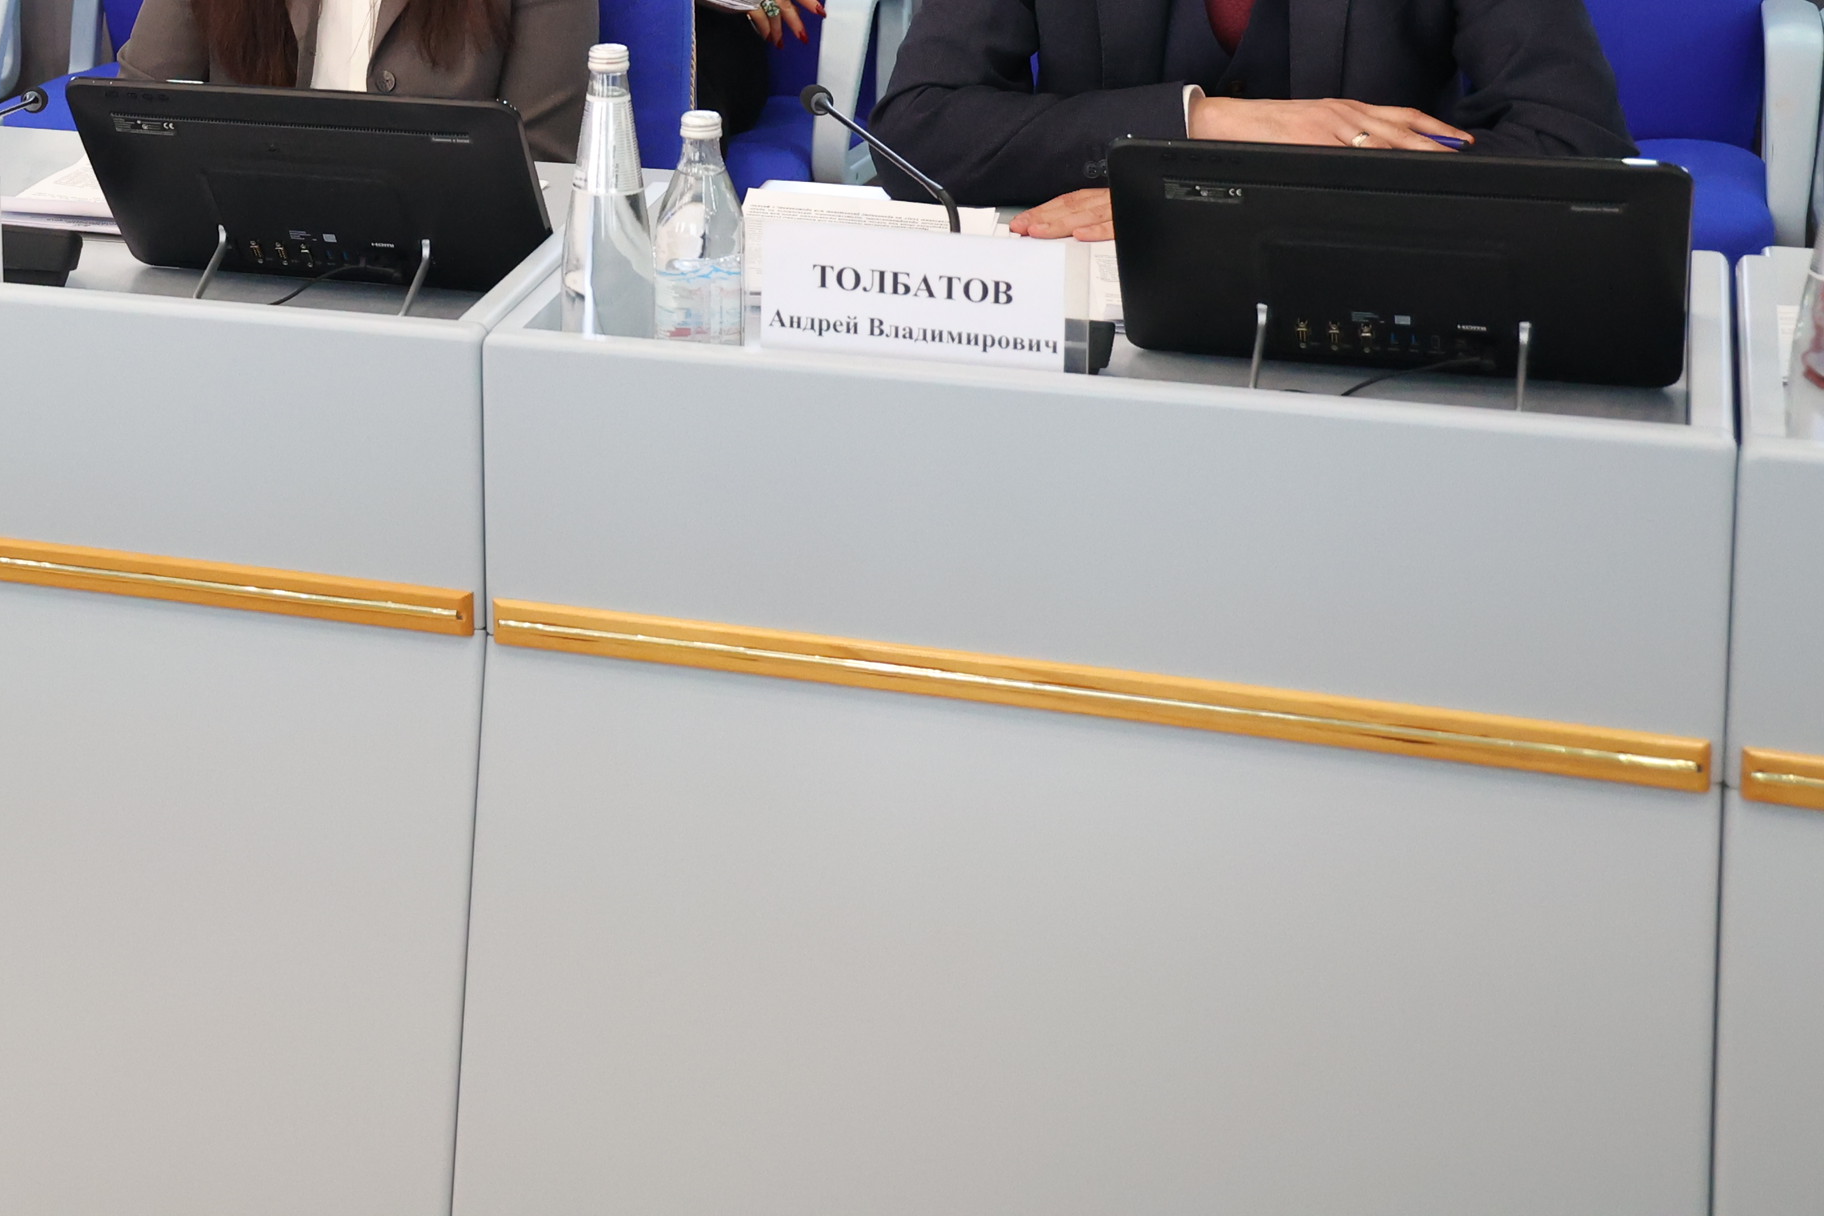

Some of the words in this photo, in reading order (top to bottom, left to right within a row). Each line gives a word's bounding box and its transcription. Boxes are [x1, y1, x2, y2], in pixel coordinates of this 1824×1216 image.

[812, 264, 1014, 305] ТОЛБАТОВ
[768, 309, 859, 338] Андрей
[868, 317, 1058, 355] Владимирович
